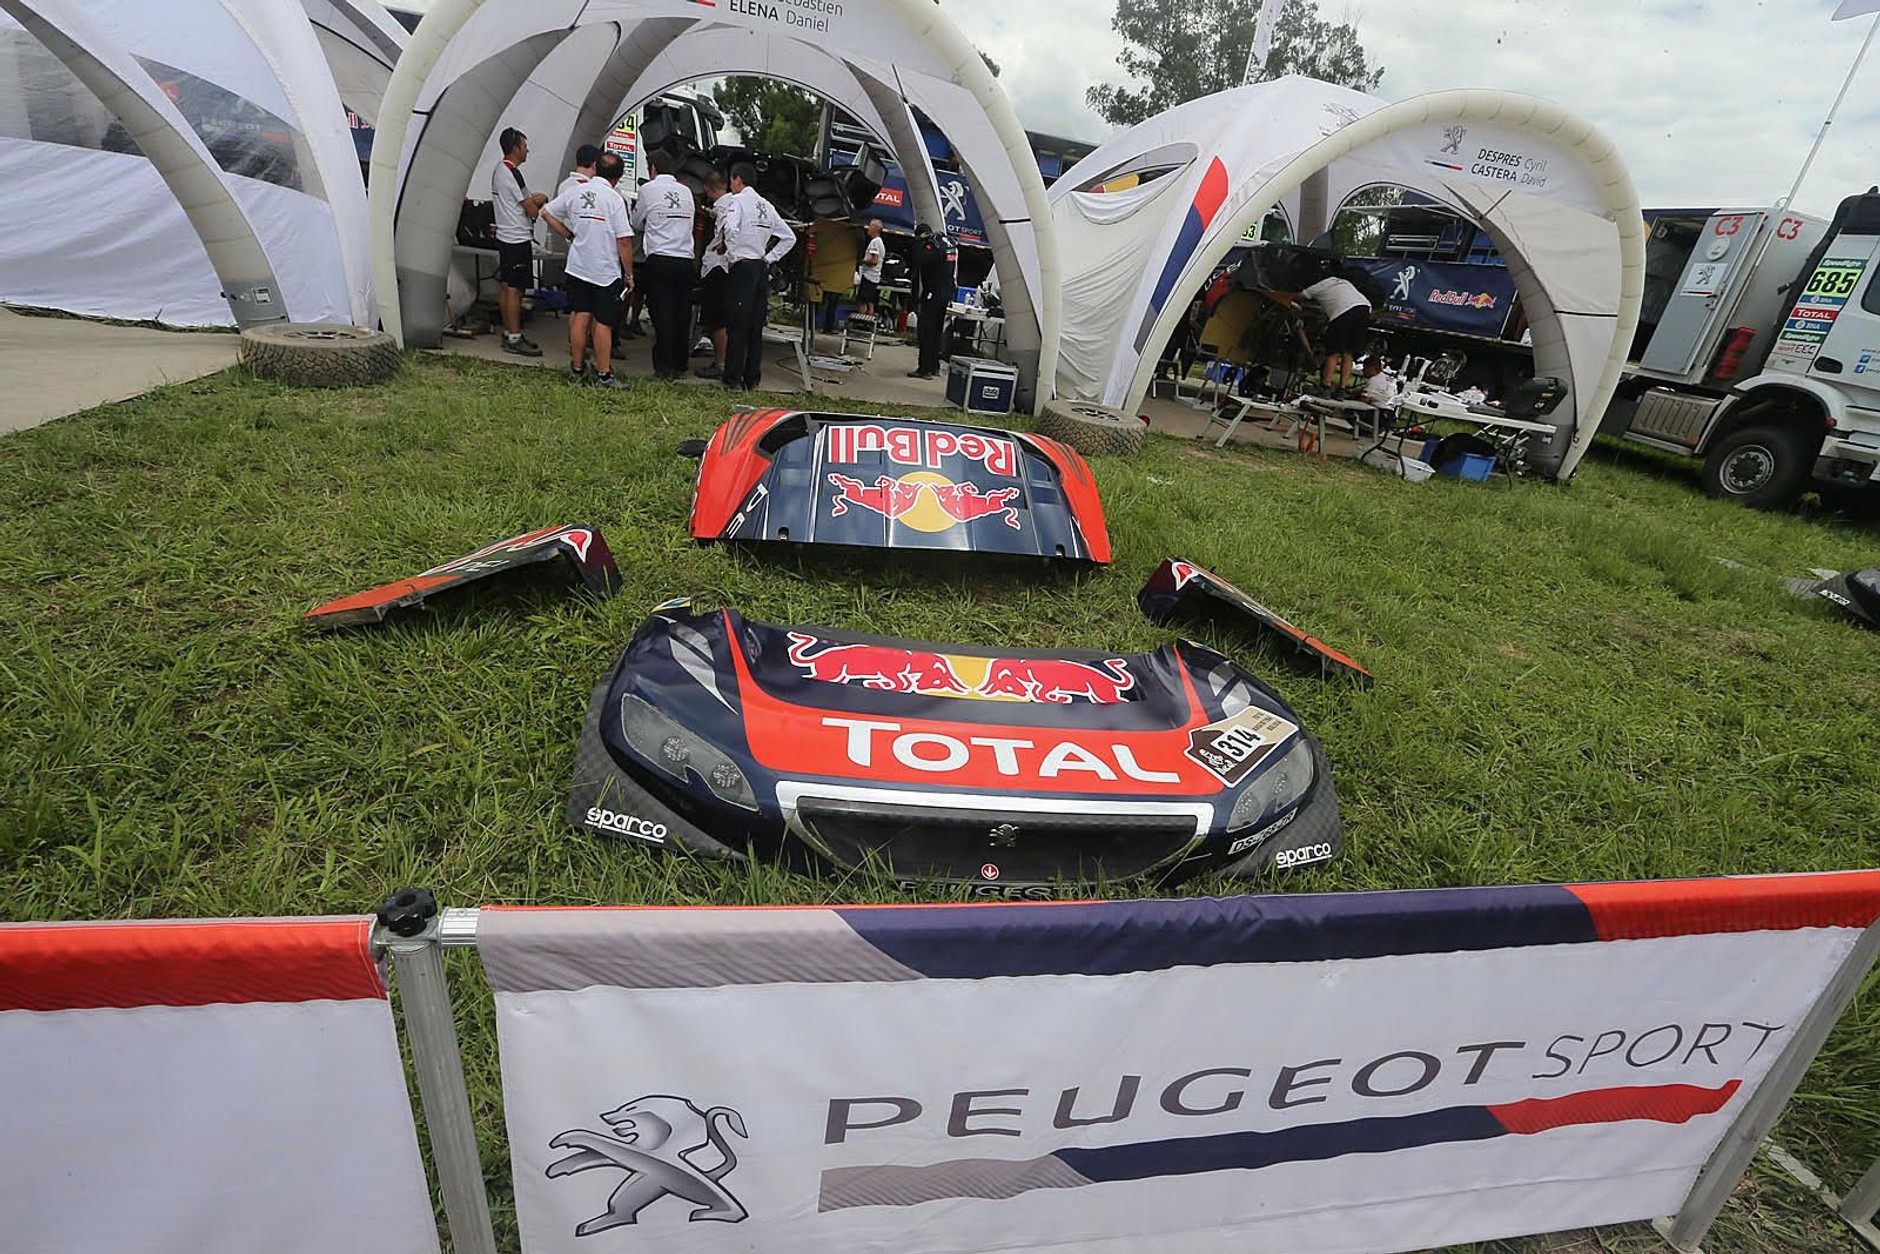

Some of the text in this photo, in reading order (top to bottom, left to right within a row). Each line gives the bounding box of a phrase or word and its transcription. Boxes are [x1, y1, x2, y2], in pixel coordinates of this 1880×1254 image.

[729, 0, 830, 33] ELENA Daniel
[608, 142, 633, 152] TOTAL
[1477, 148, 1548, 173] DESPRES Cyril
[1471, 163, 1546, 188] CASTERA David
[1714, 216, 1744, 236] C3
[1776, 217, 1803, 241] C3
[1806, 271, 1857, 294] 685
[1797, 308, 1832, 320] TOTAL
[828, 425, 1017, 477] Red Bull
[821, 717, 1181, 784] TOTAL
[1217, 728, 1261, 758] 314
[586, 806, 668, 839] sparco
[1275, 842, 1332, 867] sparco
[823, 1021, 1787, 1145] PEUGEOT SPORT
